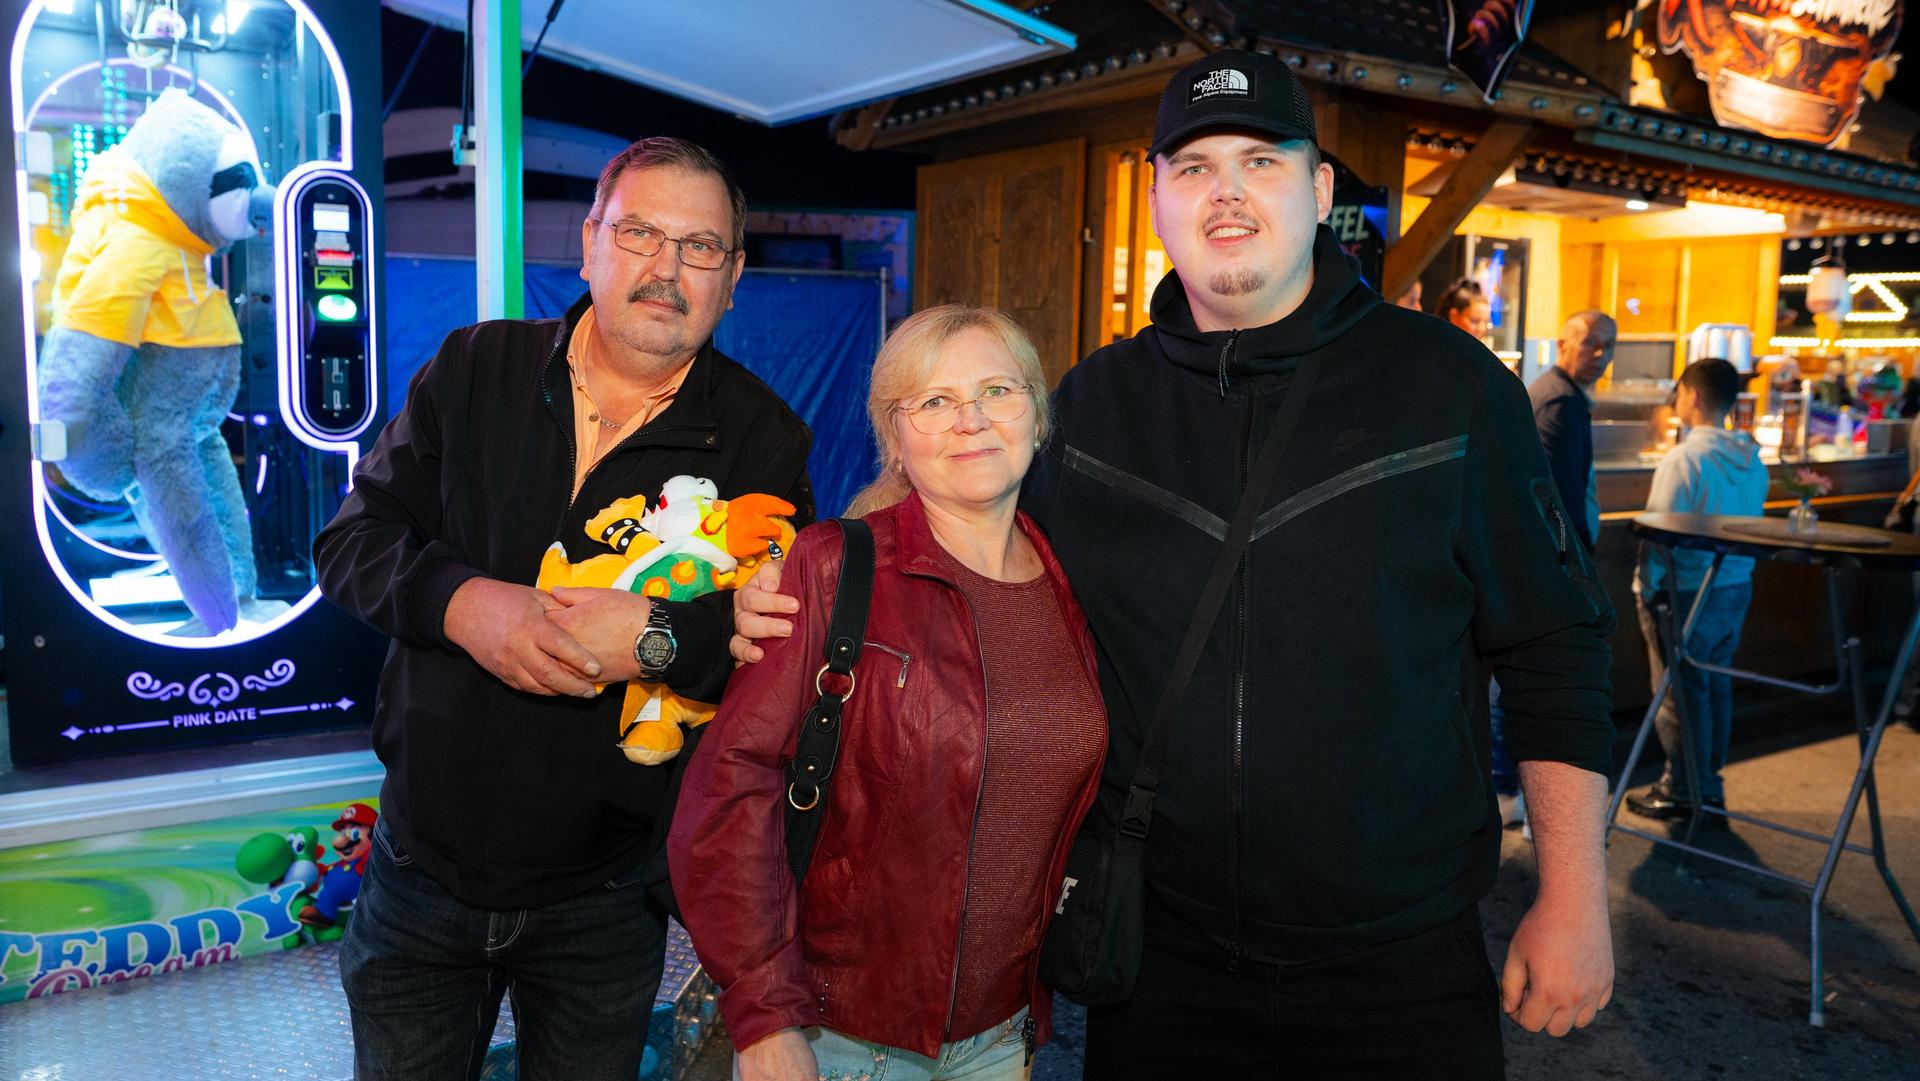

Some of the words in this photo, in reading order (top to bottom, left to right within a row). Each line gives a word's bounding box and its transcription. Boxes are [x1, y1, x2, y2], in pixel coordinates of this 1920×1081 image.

[1209, 69, 1230, 80] THE
[1194, 75, 1229, 91] NORTH
[1201, 82, 1228, 94] FACE
[1324, 205, 1369, 241] FEL
[173, 711, 212, 728] PINK
[214, 707, 257, 724] DATE
